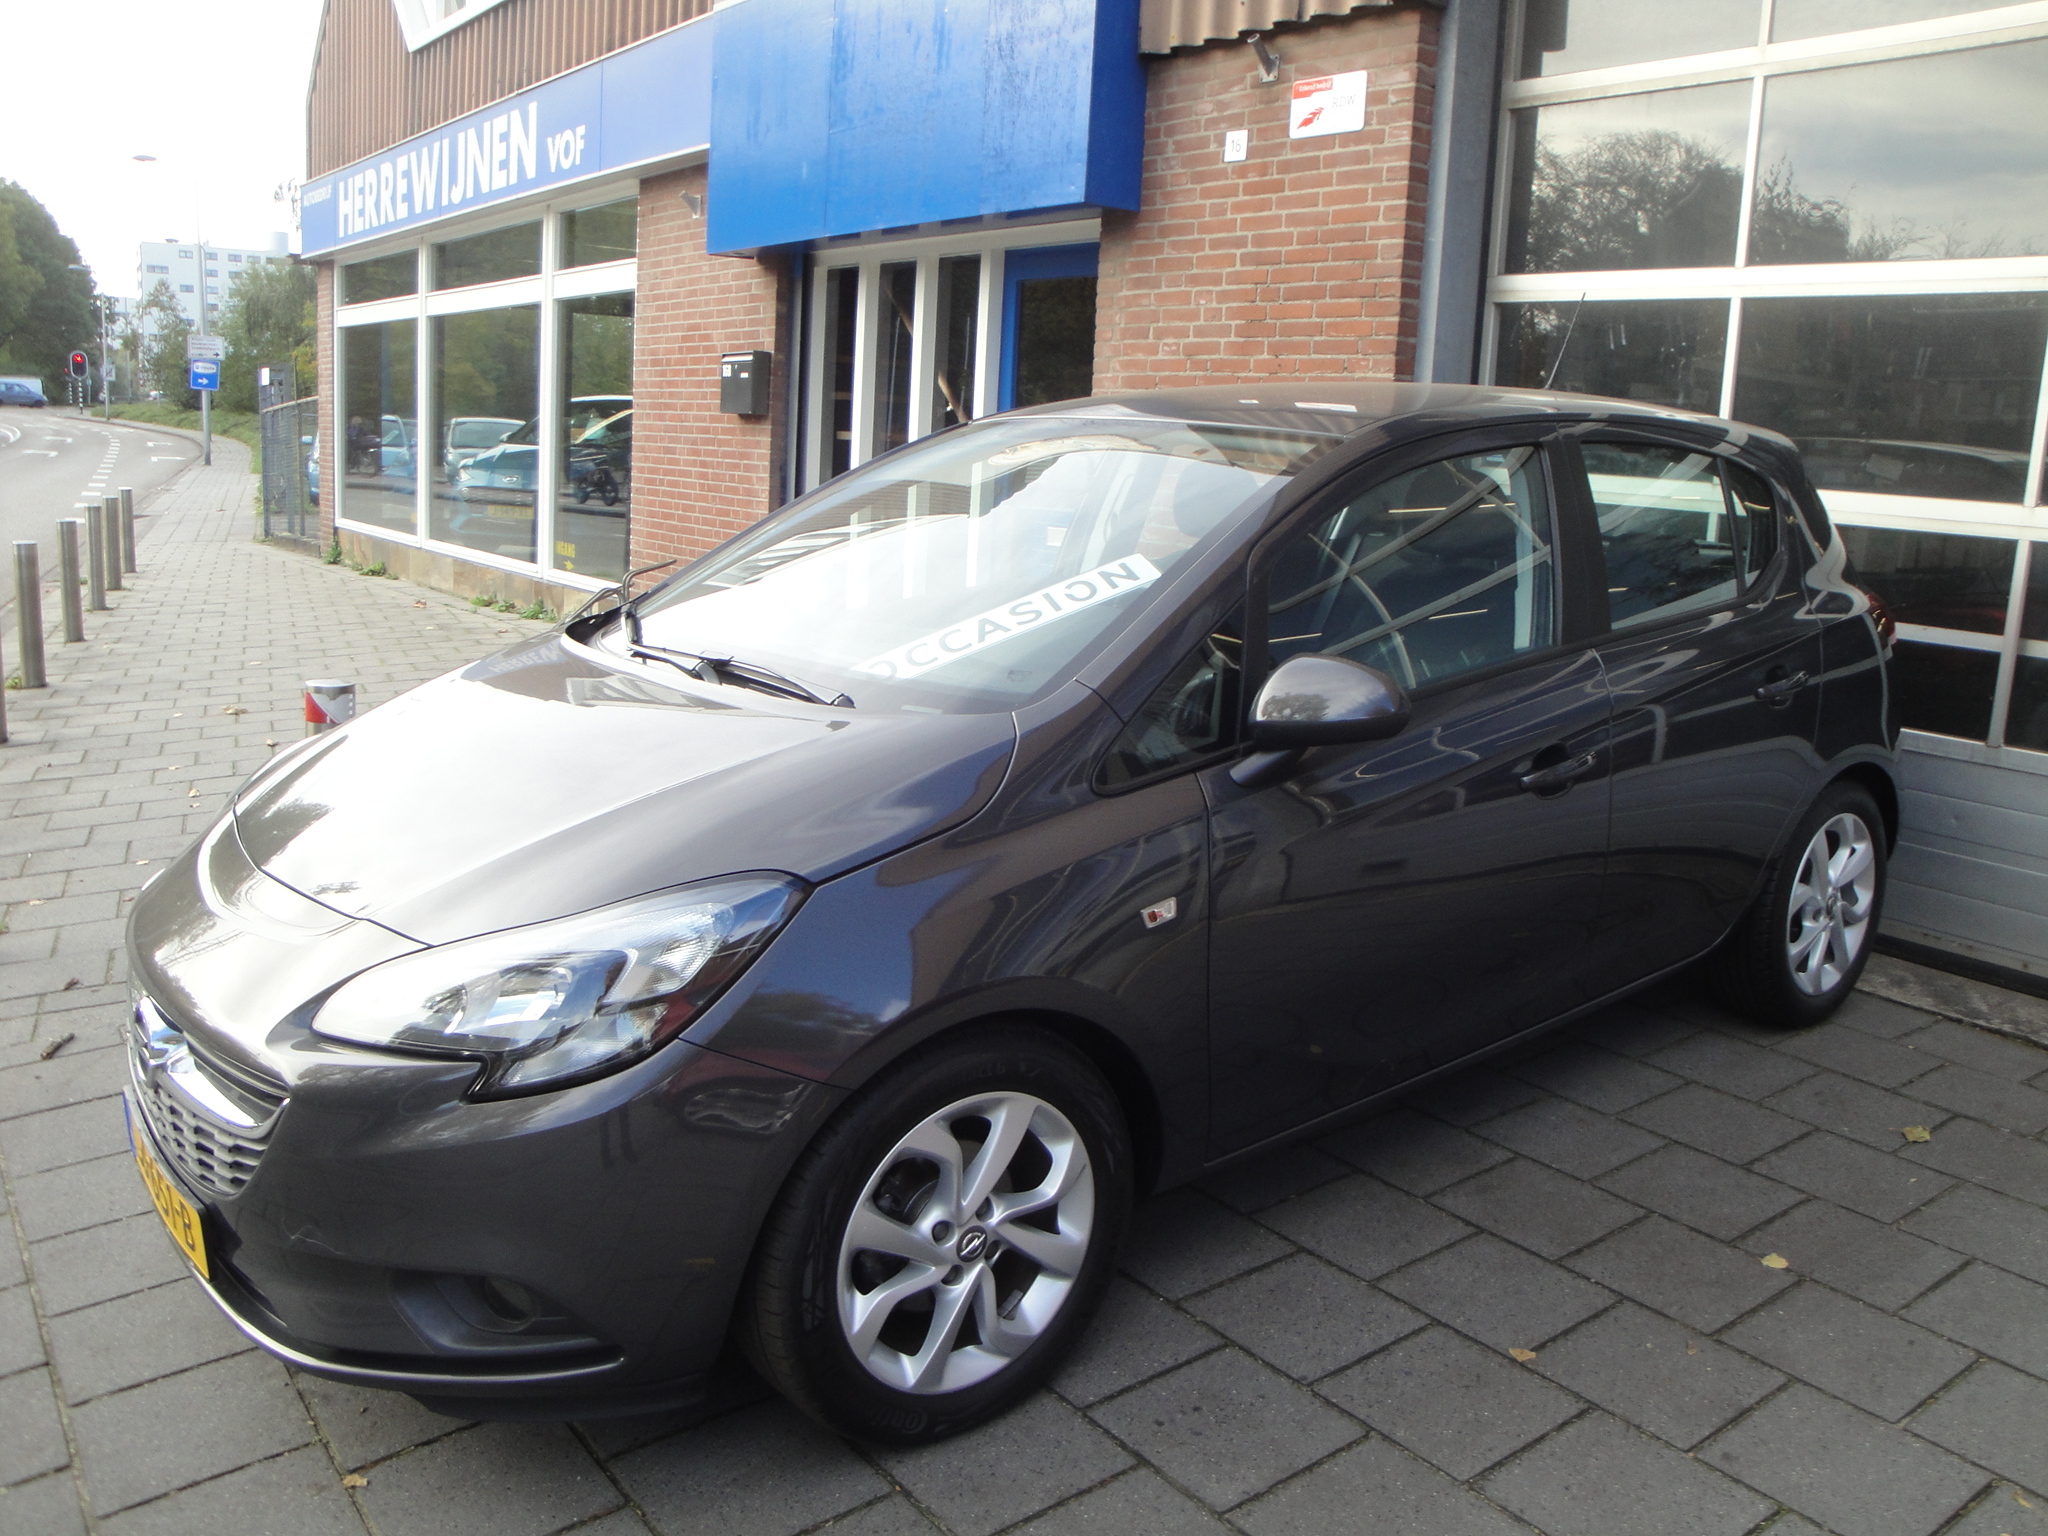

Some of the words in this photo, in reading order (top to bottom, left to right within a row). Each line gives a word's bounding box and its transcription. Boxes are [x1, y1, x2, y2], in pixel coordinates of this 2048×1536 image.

[1331, 94, 1357, 108] RDW
[338, 101, 538, 238] HERREWIJNEN
[547, 124, 586, 173] VOF
[1230, 138, 1242, 153] 16
[867, 561, 1141, 682] OCCASION
